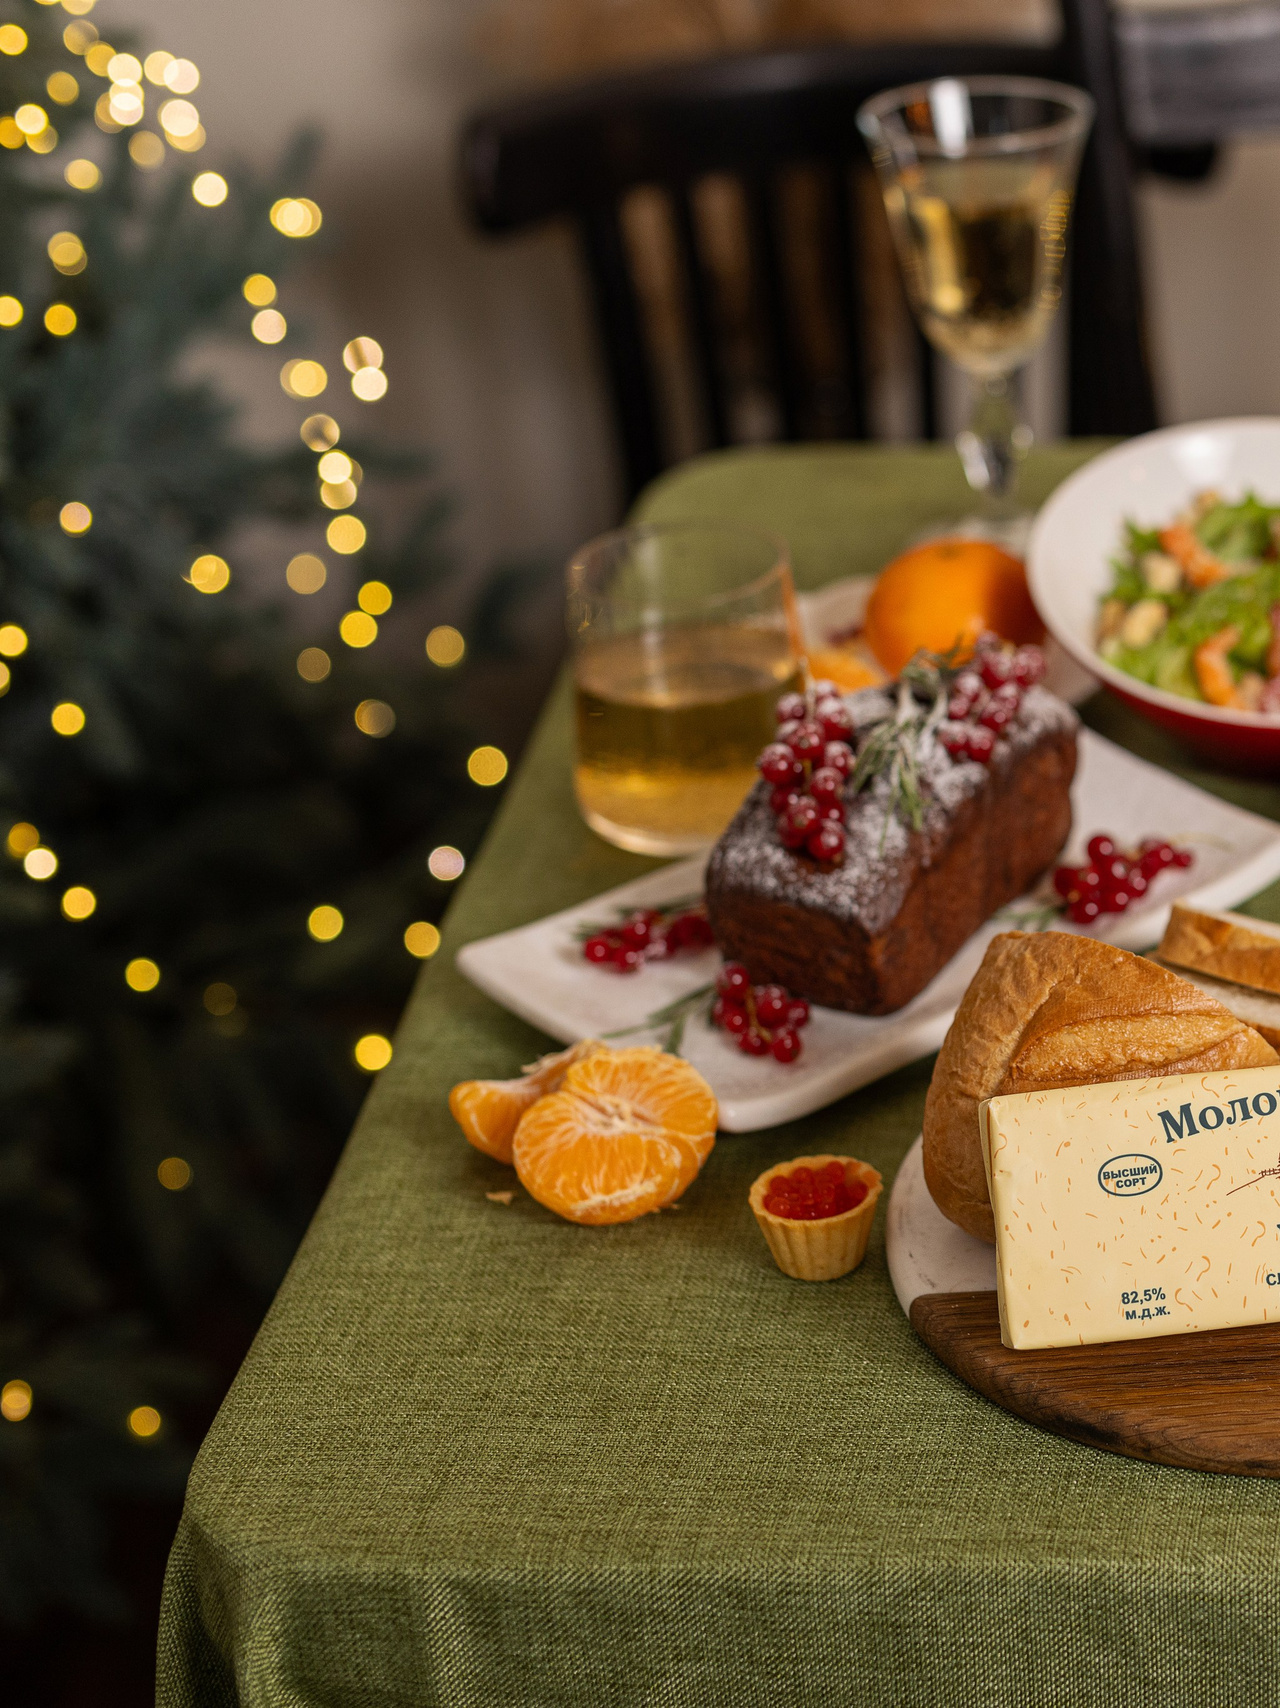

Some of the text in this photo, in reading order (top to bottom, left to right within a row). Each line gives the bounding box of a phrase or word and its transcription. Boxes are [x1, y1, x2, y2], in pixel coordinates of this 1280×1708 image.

[1102, 1163, 1159, 1180] ВЫСШИЙ
[1115, 1176, 1147, 1190] СОРТ
[1121, 1287, 1166, 1305] 82,5%
[1125, 1306, 1171, 1321] м.д.ж.
